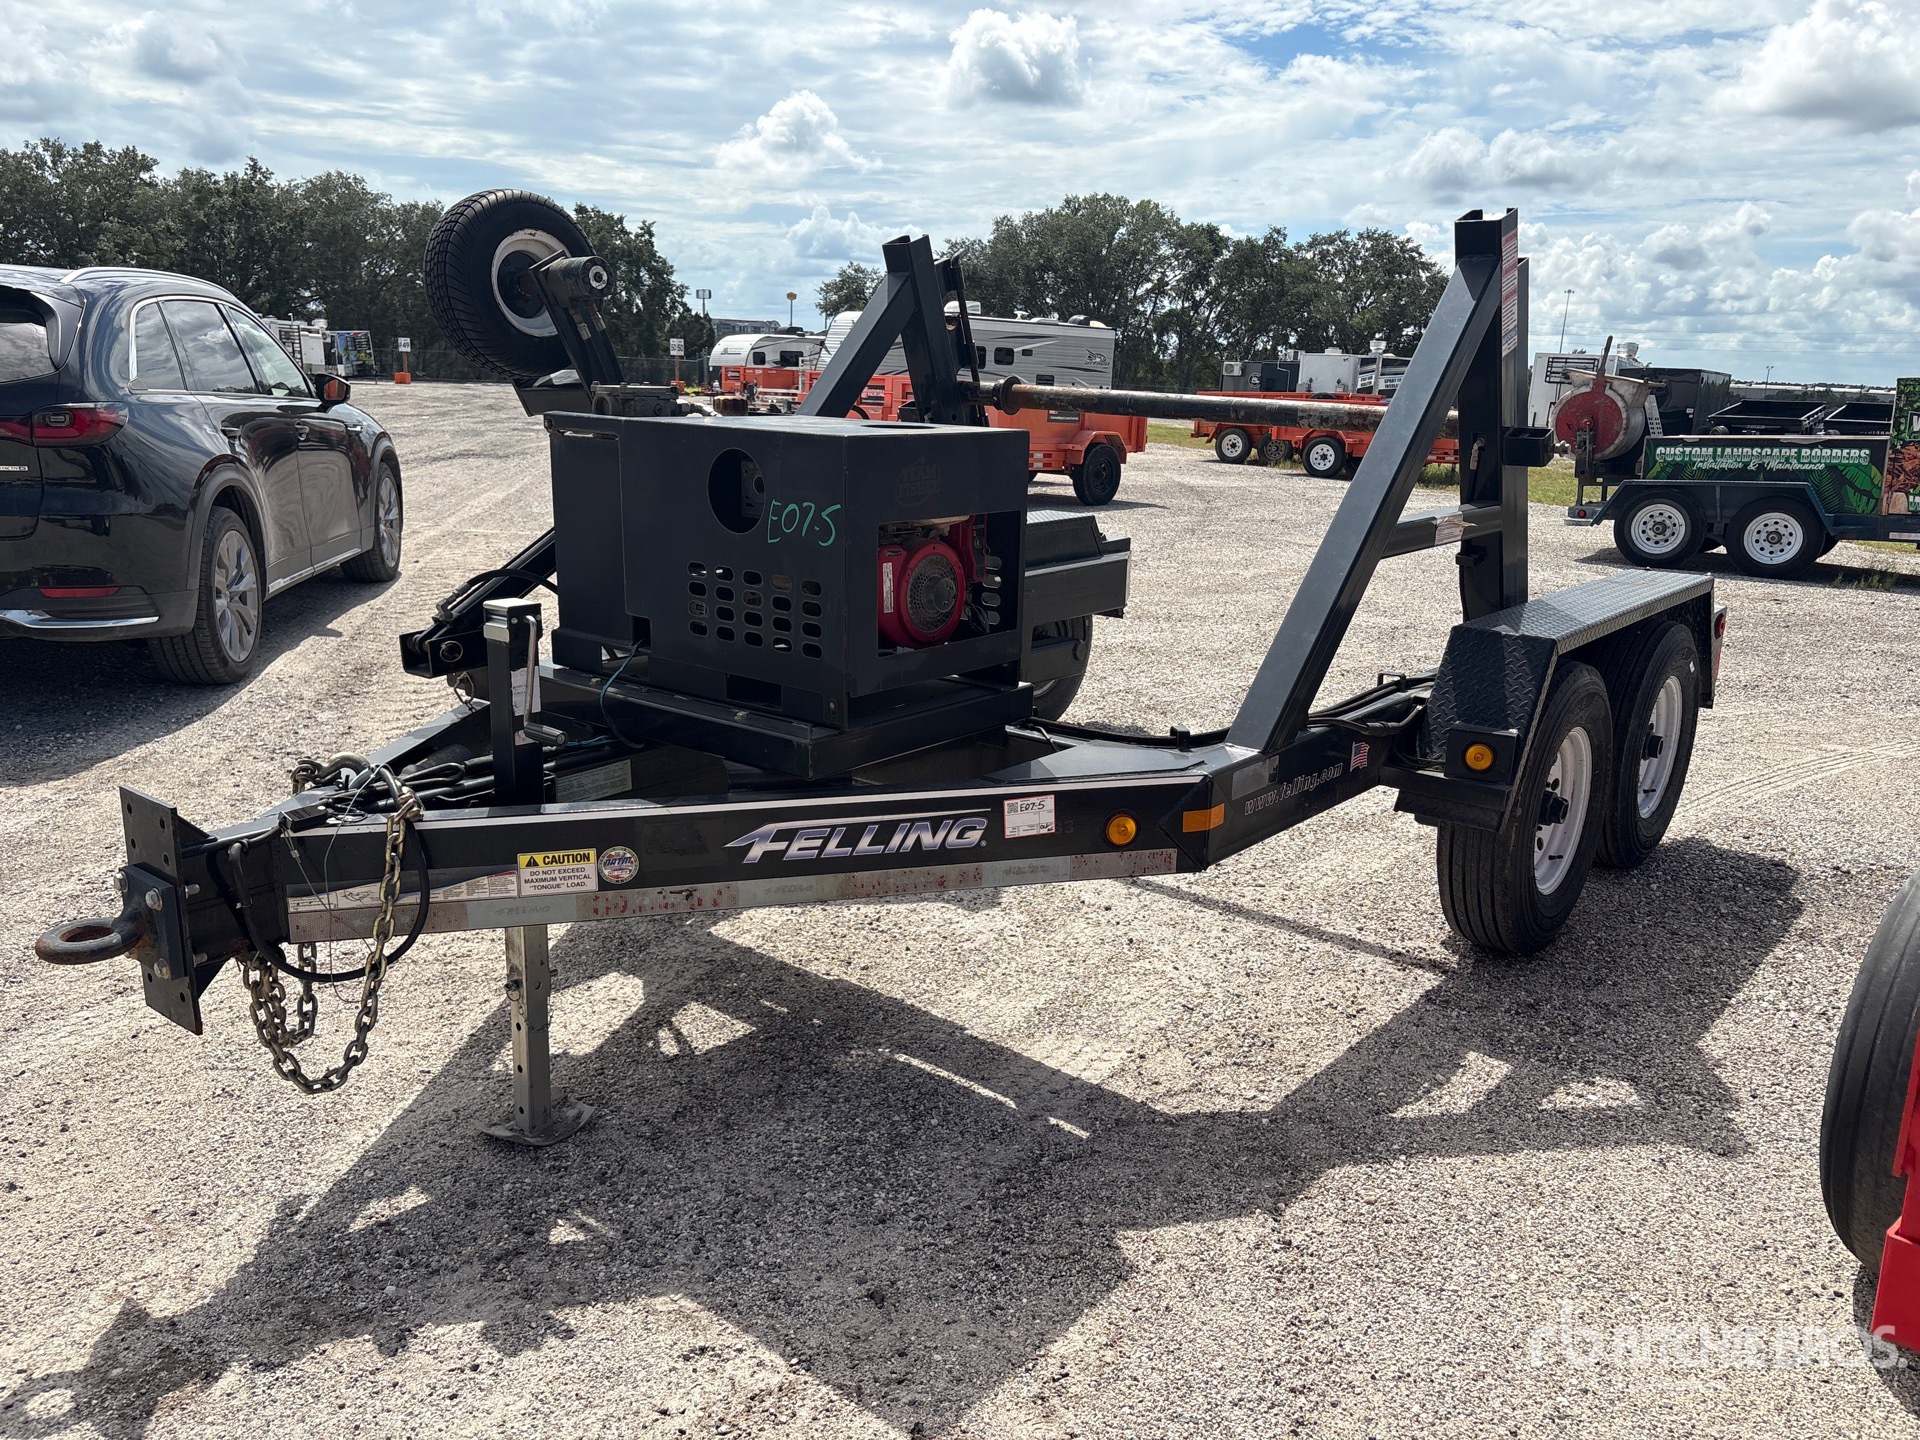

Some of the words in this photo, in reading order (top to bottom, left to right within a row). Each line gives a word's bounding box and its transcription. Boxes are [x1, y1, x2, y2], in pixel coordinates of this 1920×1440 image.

[1655, 447, 1713, 463] CUSTOM
[1715, 448, 1798, 464] LANDSCAPE
[1800, 448, 1870, 466] BORDERS
[1692, 457, 1744, 470] Installation
[1747, 460, 1758, 470] &
[1764, 458, 1826, 471] Maintenance
[1020, 800, 1045, 812] E07-5
[721, 808, 992, 865] FELLING
[542, 852, 591, 866] CAUTION
[558, 867, 586, 875] EXCEED
[524, 876, 557, 884] MAXIMUM
[558, 873, 592, 882] VERTICAL
[566, 881, 588, 889] LOAD.
